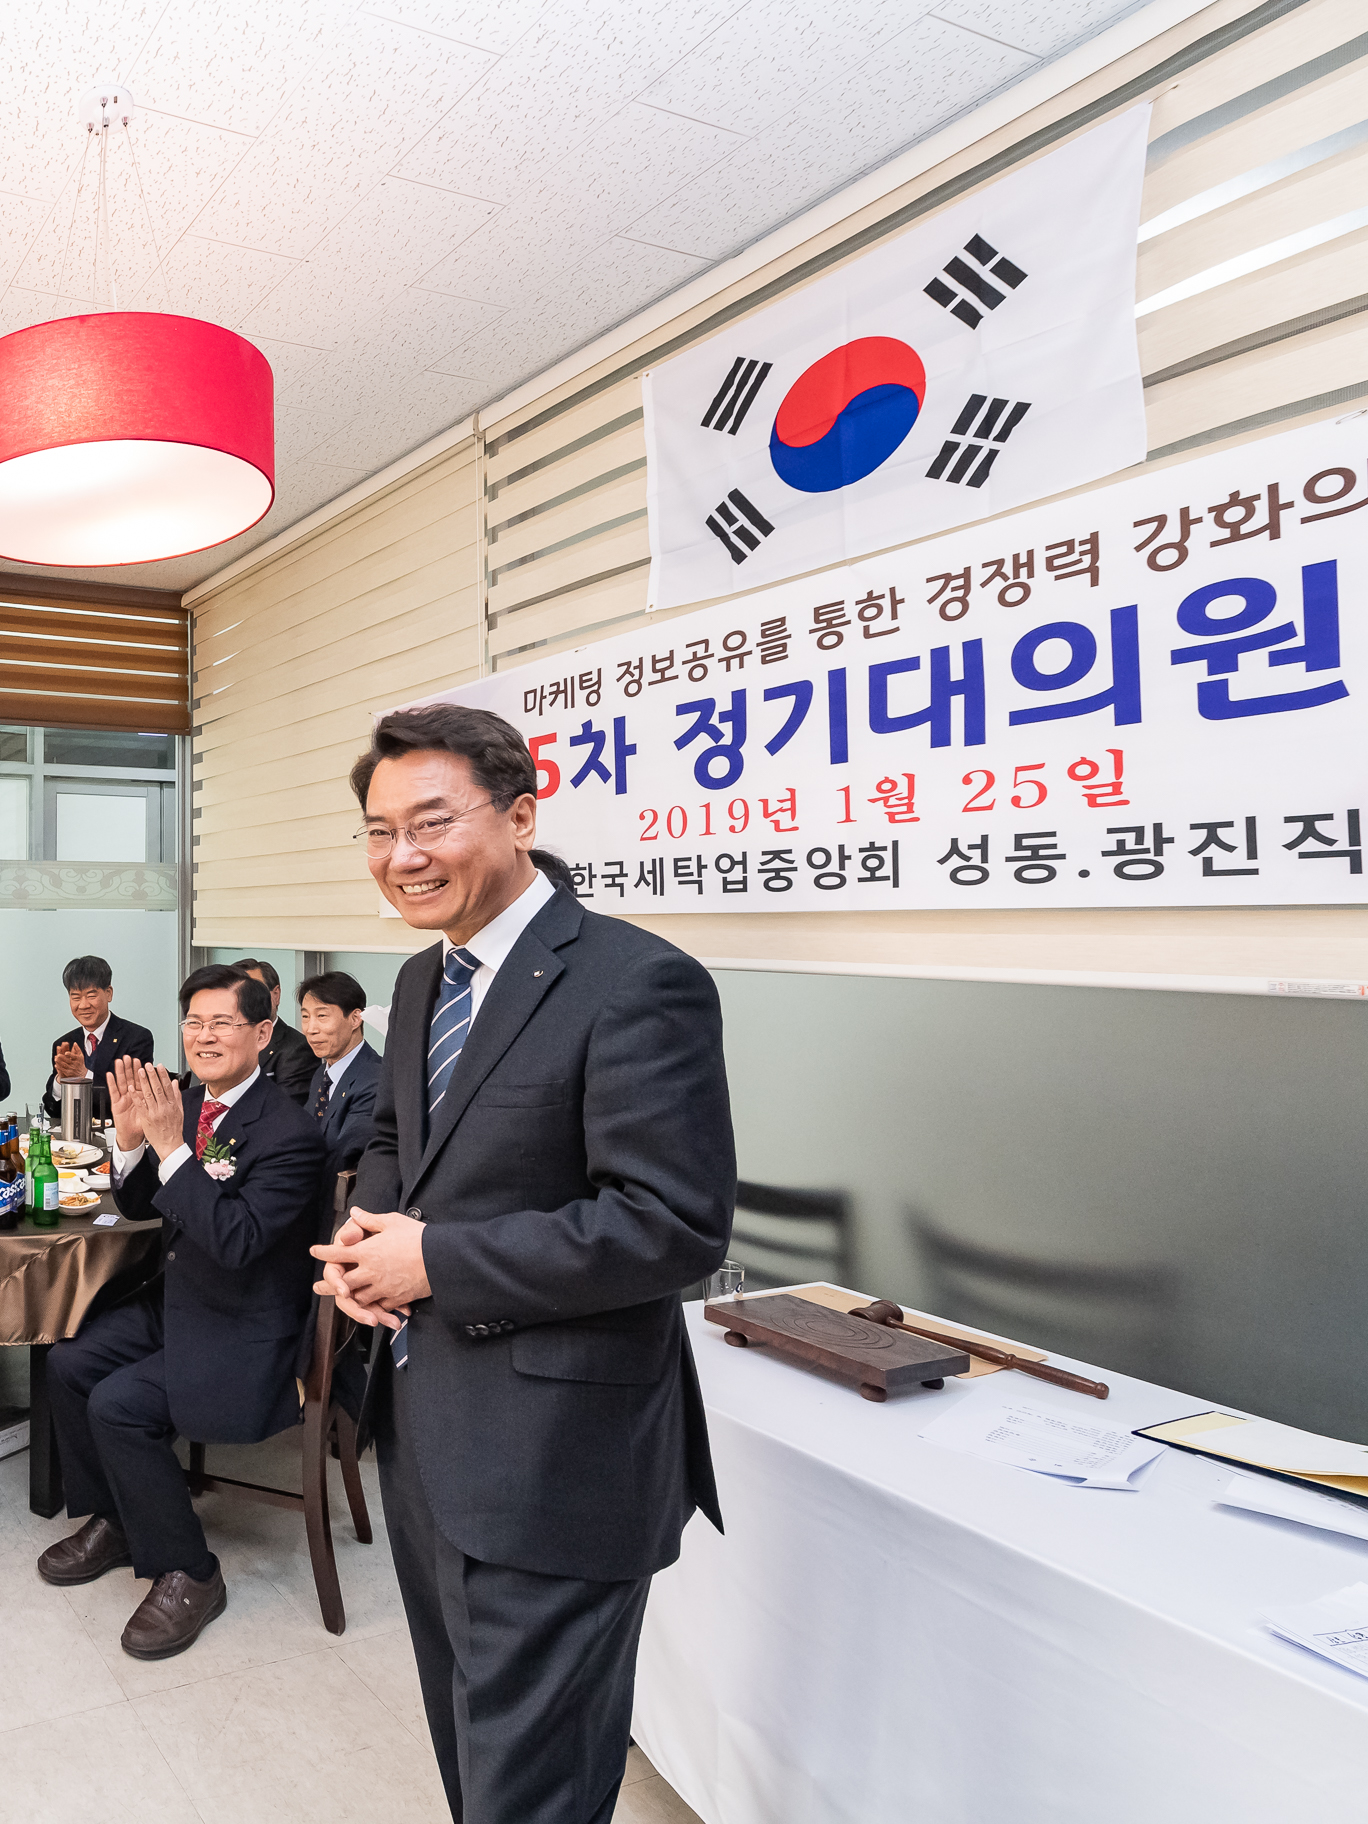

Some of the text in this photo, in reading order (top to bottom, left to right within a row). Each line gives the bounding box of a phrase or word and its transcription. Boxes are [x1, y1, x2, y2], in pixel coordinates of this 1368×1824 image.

[523, 458, 1368, 717] 마케팅 정보공유를 통한 경쟁력 강화의
[673, 558, 1351, 790] 정기대의원
[570, 838, 900, 898] 한국세탁업중앙회
[639, 748, 1131, 842] 2019년 1월 25일
